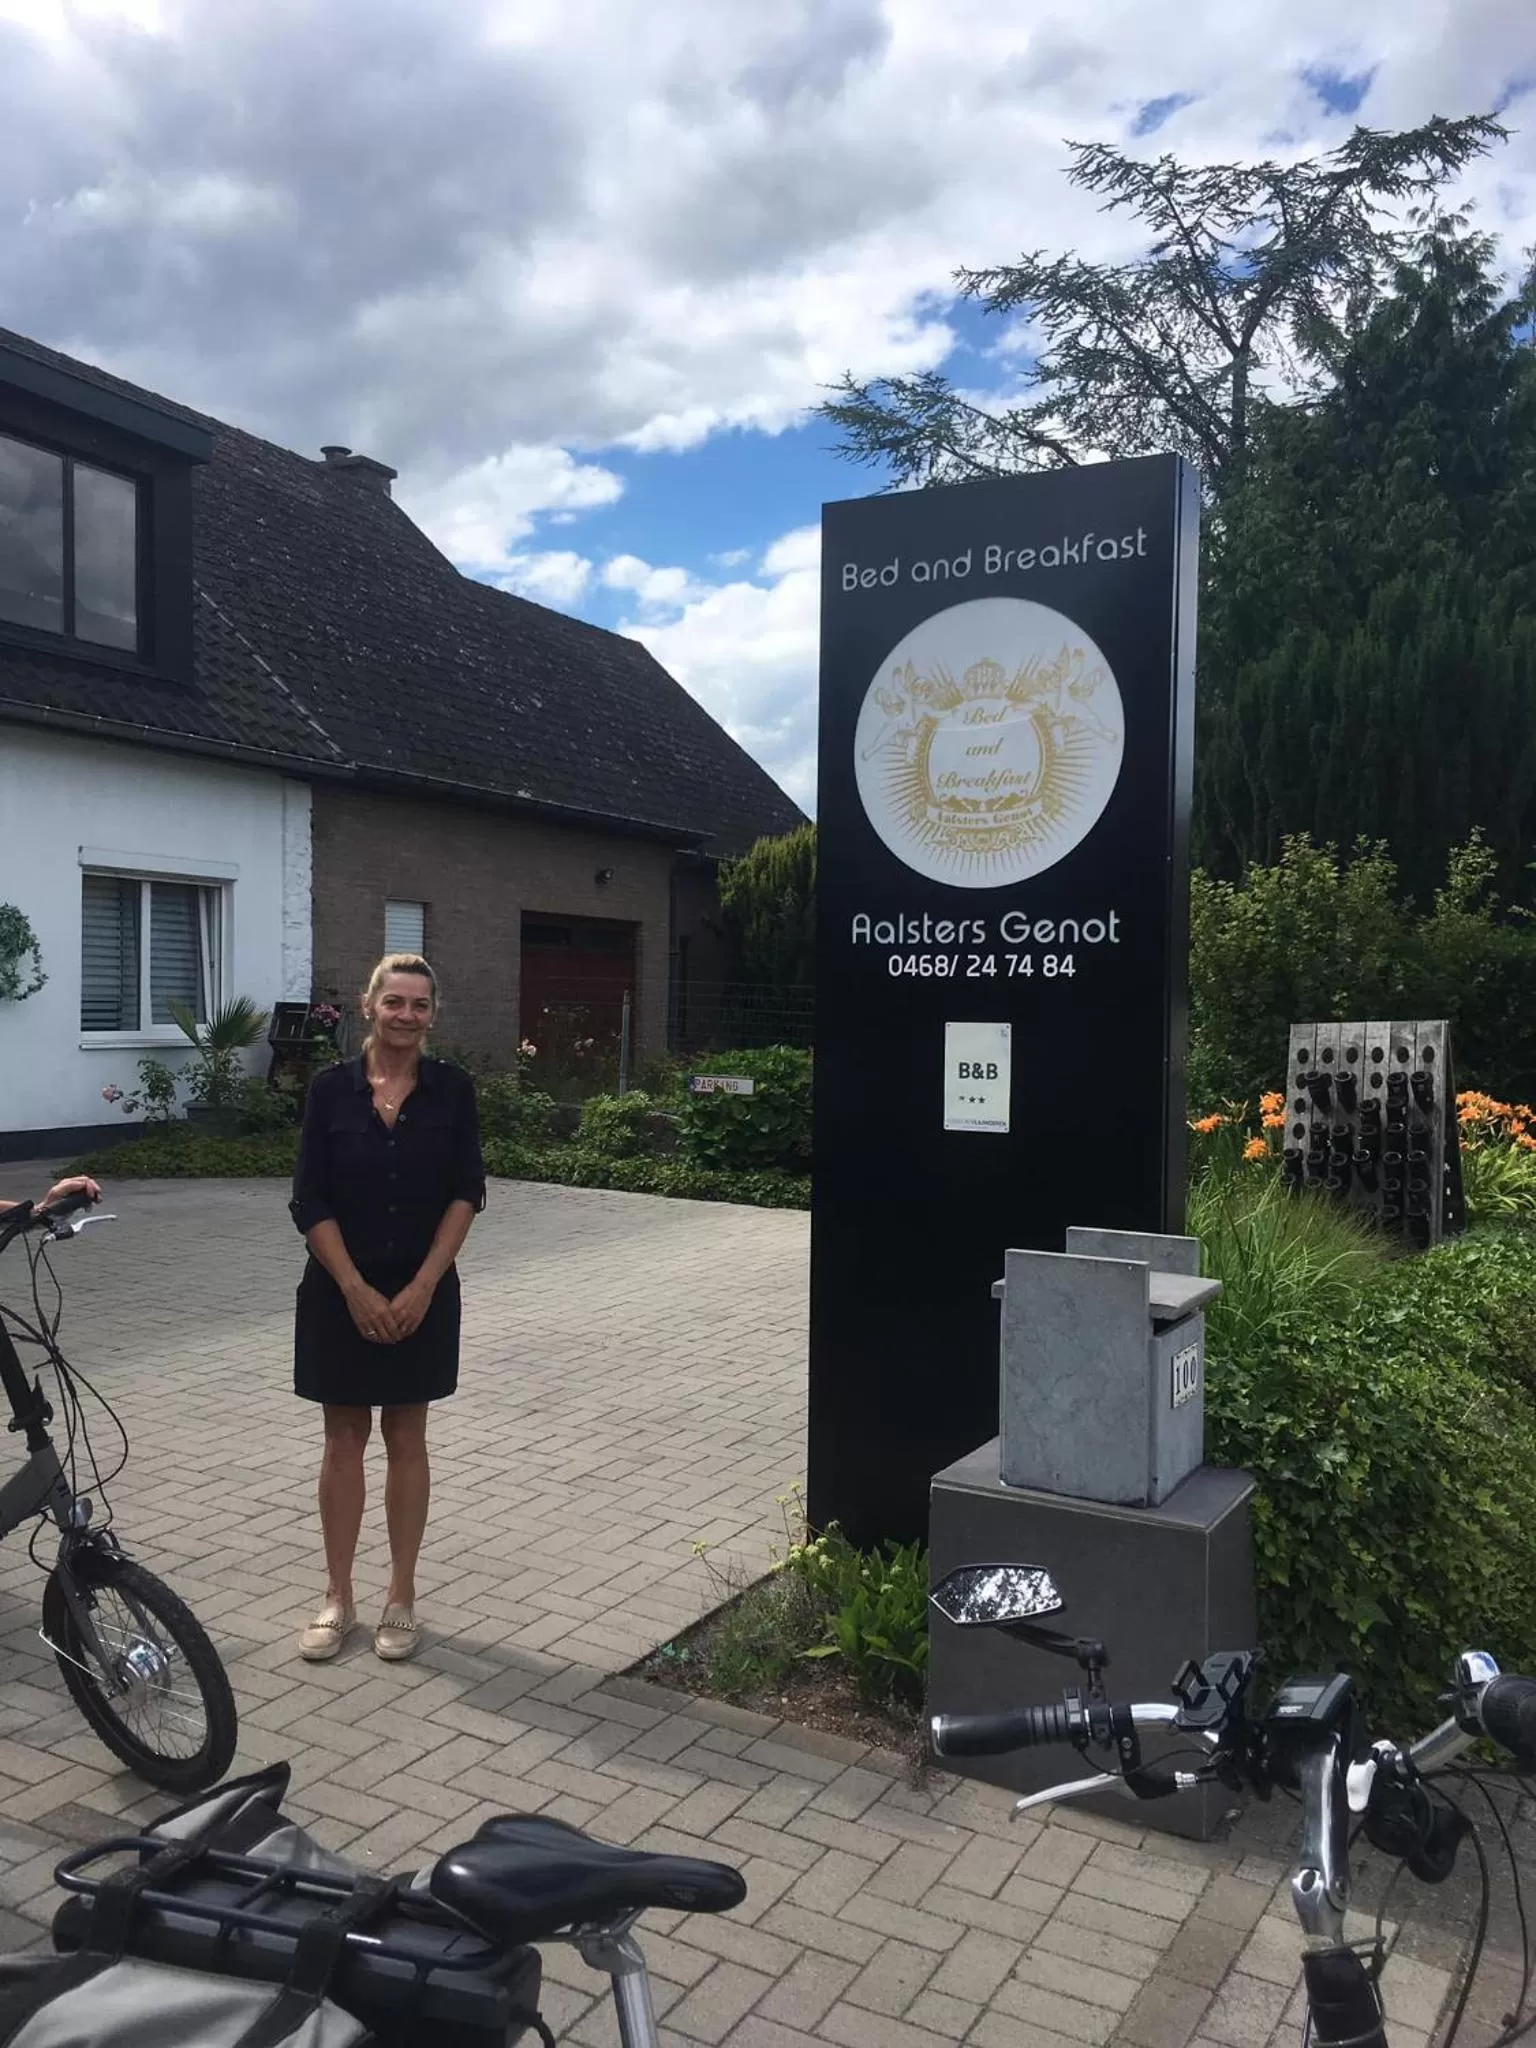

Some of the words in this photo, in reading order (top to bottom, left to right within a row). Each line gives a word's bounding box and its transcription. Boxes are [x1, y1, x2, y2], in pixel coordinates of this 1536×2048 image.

[842, 558, 899, 592] Bed
[911, 548, 973, 583] and
[984, 526, 1148, 575] Breakfast
[963, 705, 1007, 725] Bed
[965, 737, 1004, 757] and
[936, 769, 1032, 793] Breakfast
[852, 912, 986, 944] Aalsters
[1000, 909, 1121, 943] Genot
[888, 954, 959, 977] 0468/
[966, 954, 997, 977] 24
[1004, 954, 1034, 977] 74
[1042, 954, 1076, 977] 84
[958, 1062, 998, 1080] B&B
[1175, 1355, 1197, 1395] 100
